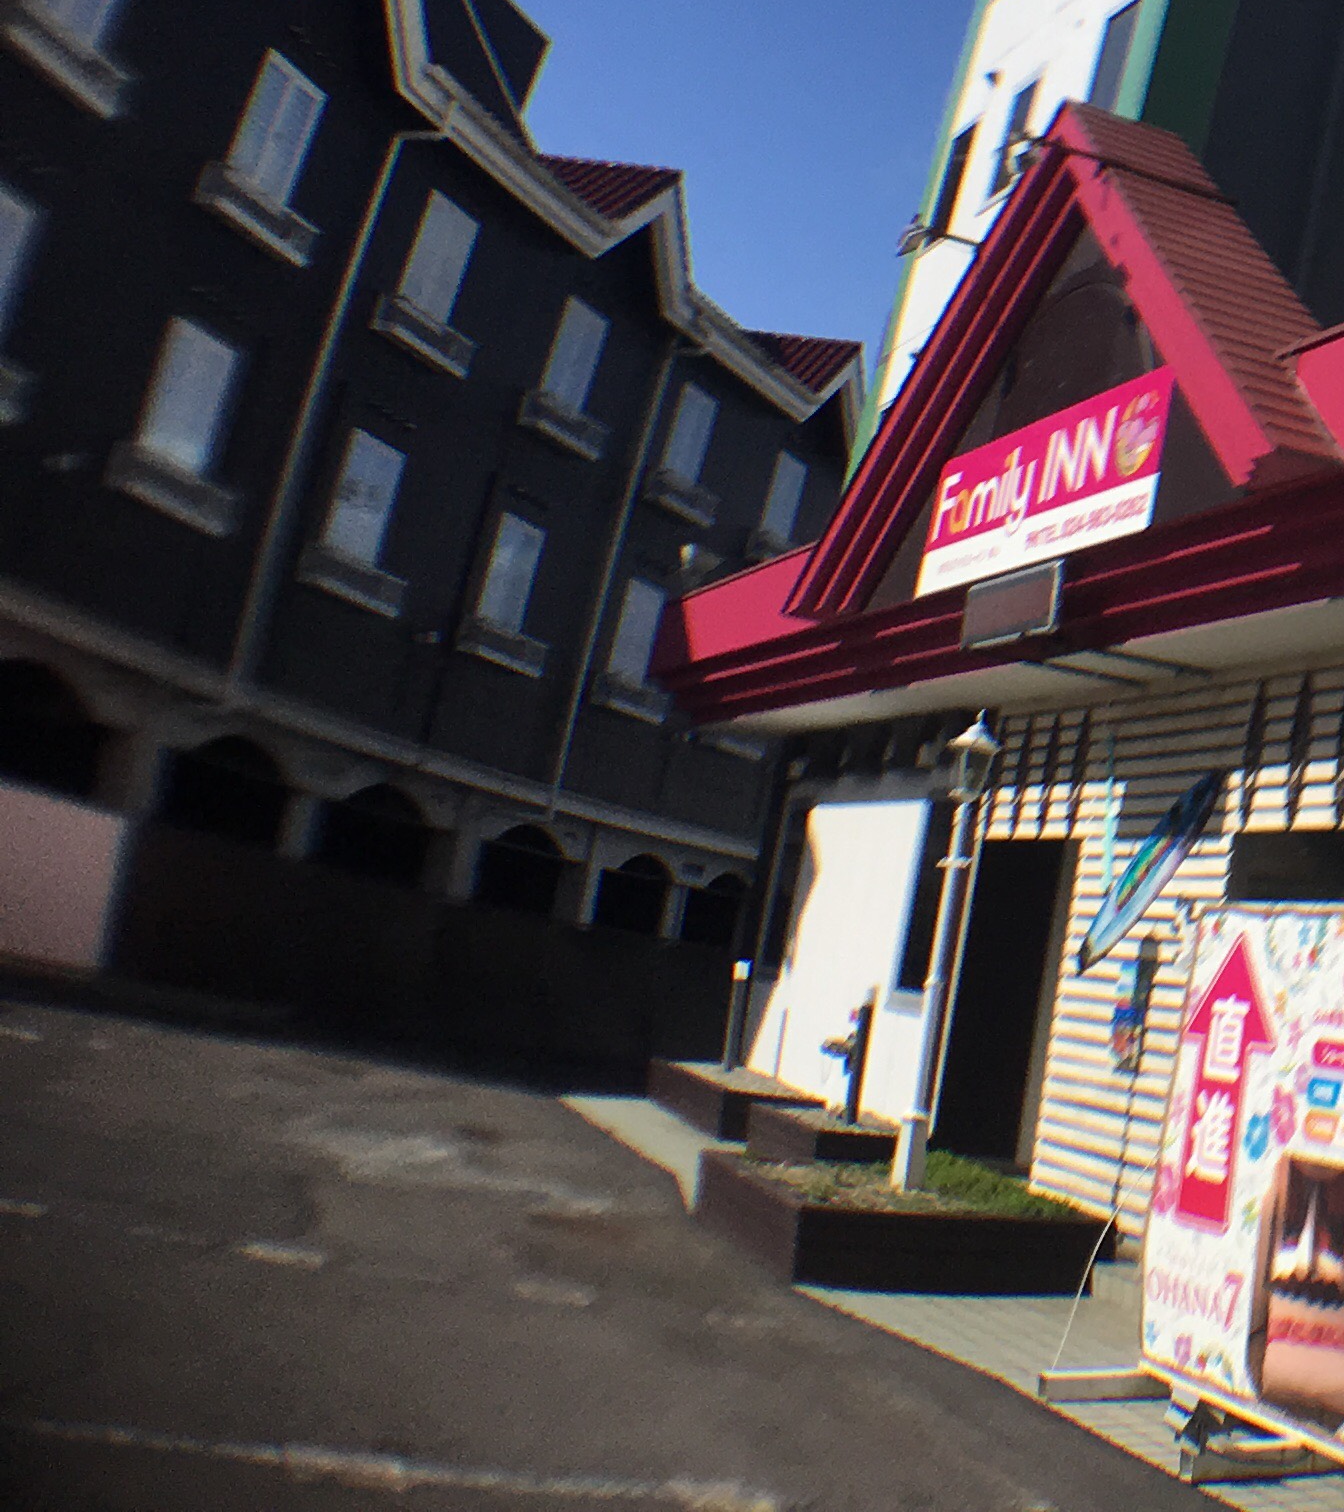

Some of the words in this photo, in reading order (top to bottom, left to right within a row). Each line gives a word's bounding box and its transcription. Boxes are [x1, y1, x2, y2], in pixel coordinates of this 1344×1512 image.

[930, 445, 1038, 541] Family
[1036, 405, 1120, 505] INN
[1185, 993, 1251, 1185] 直進
